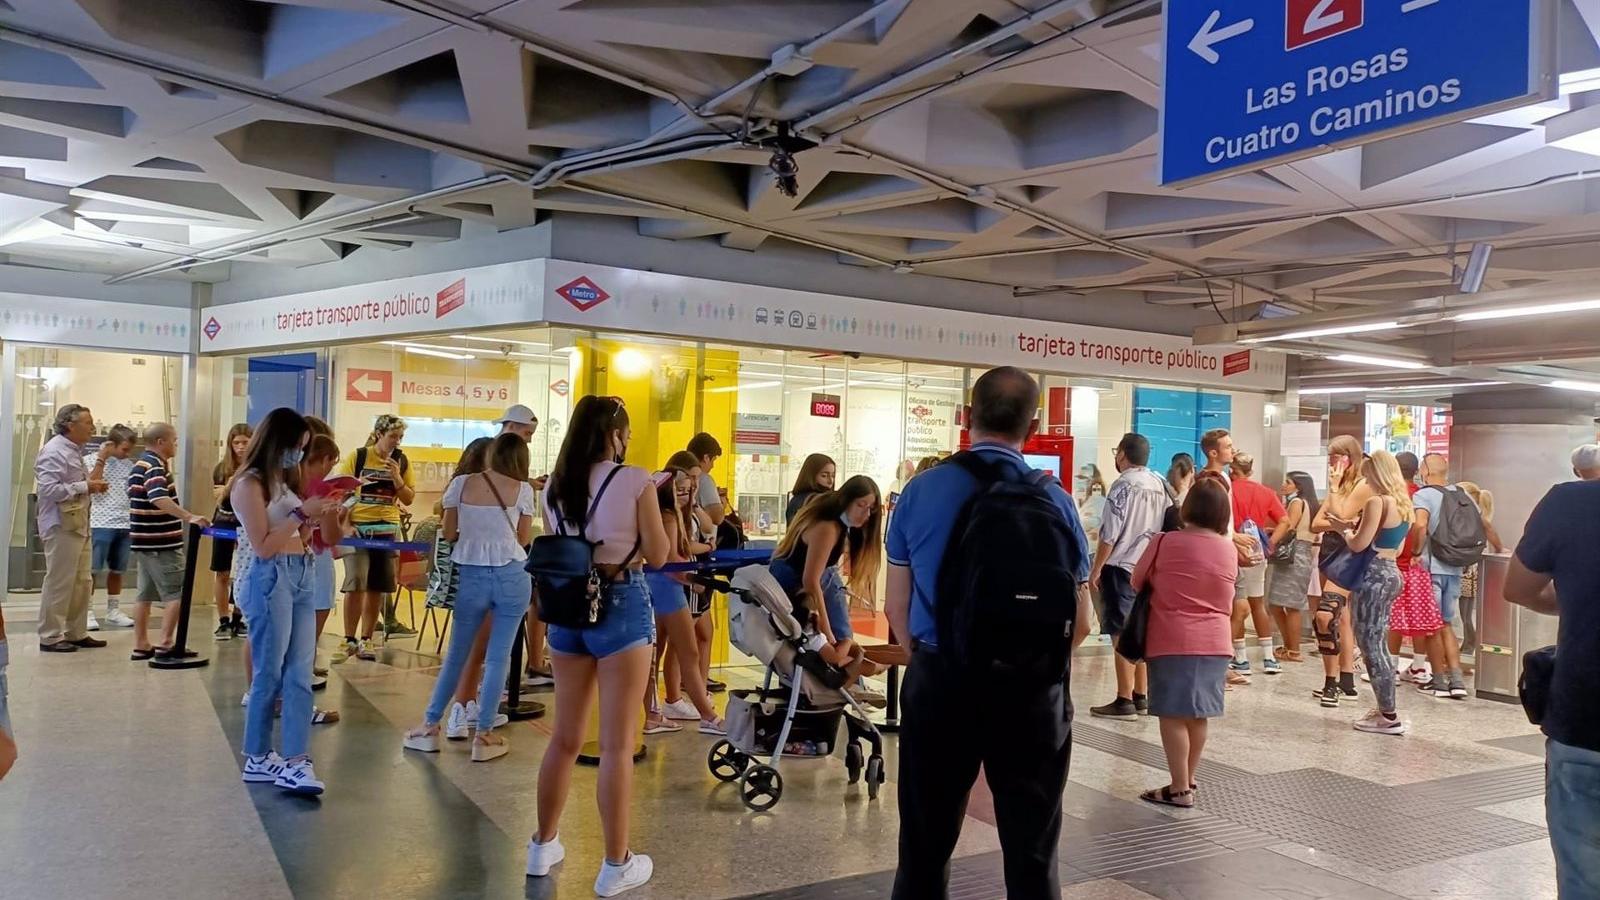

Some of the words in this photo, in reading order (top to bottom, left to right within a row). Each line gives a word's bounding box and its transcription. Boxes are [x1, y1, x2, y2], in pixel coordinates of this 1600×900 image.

[1246, 80, 1296, 115] Las
[1307, 46, 1409, 97] Rosas
[1204, 121, 1300, 165] Cuatro
[1309, 77, 1461, 138] Caminos
[277, 308, 313, 332] tarjeta
[316, 300, 380, 326] transporte
[383, 293, 430, 322] público
[571, 288, 595, 300] Metro
[1018, 333, 1075, 358] tarjeta
[1080, 339, 1163, 366] transporte
[1167, 349, 1217, 371] público
[401, 381, 450, 396] Mesas
[456, 385, 469, 400] 4,
[473, 386, 481, 398] 5
[487, 388, 495, 402] y
[499, 387, 508, 400] 6
[1430, 425, 1447, 436] KFC
